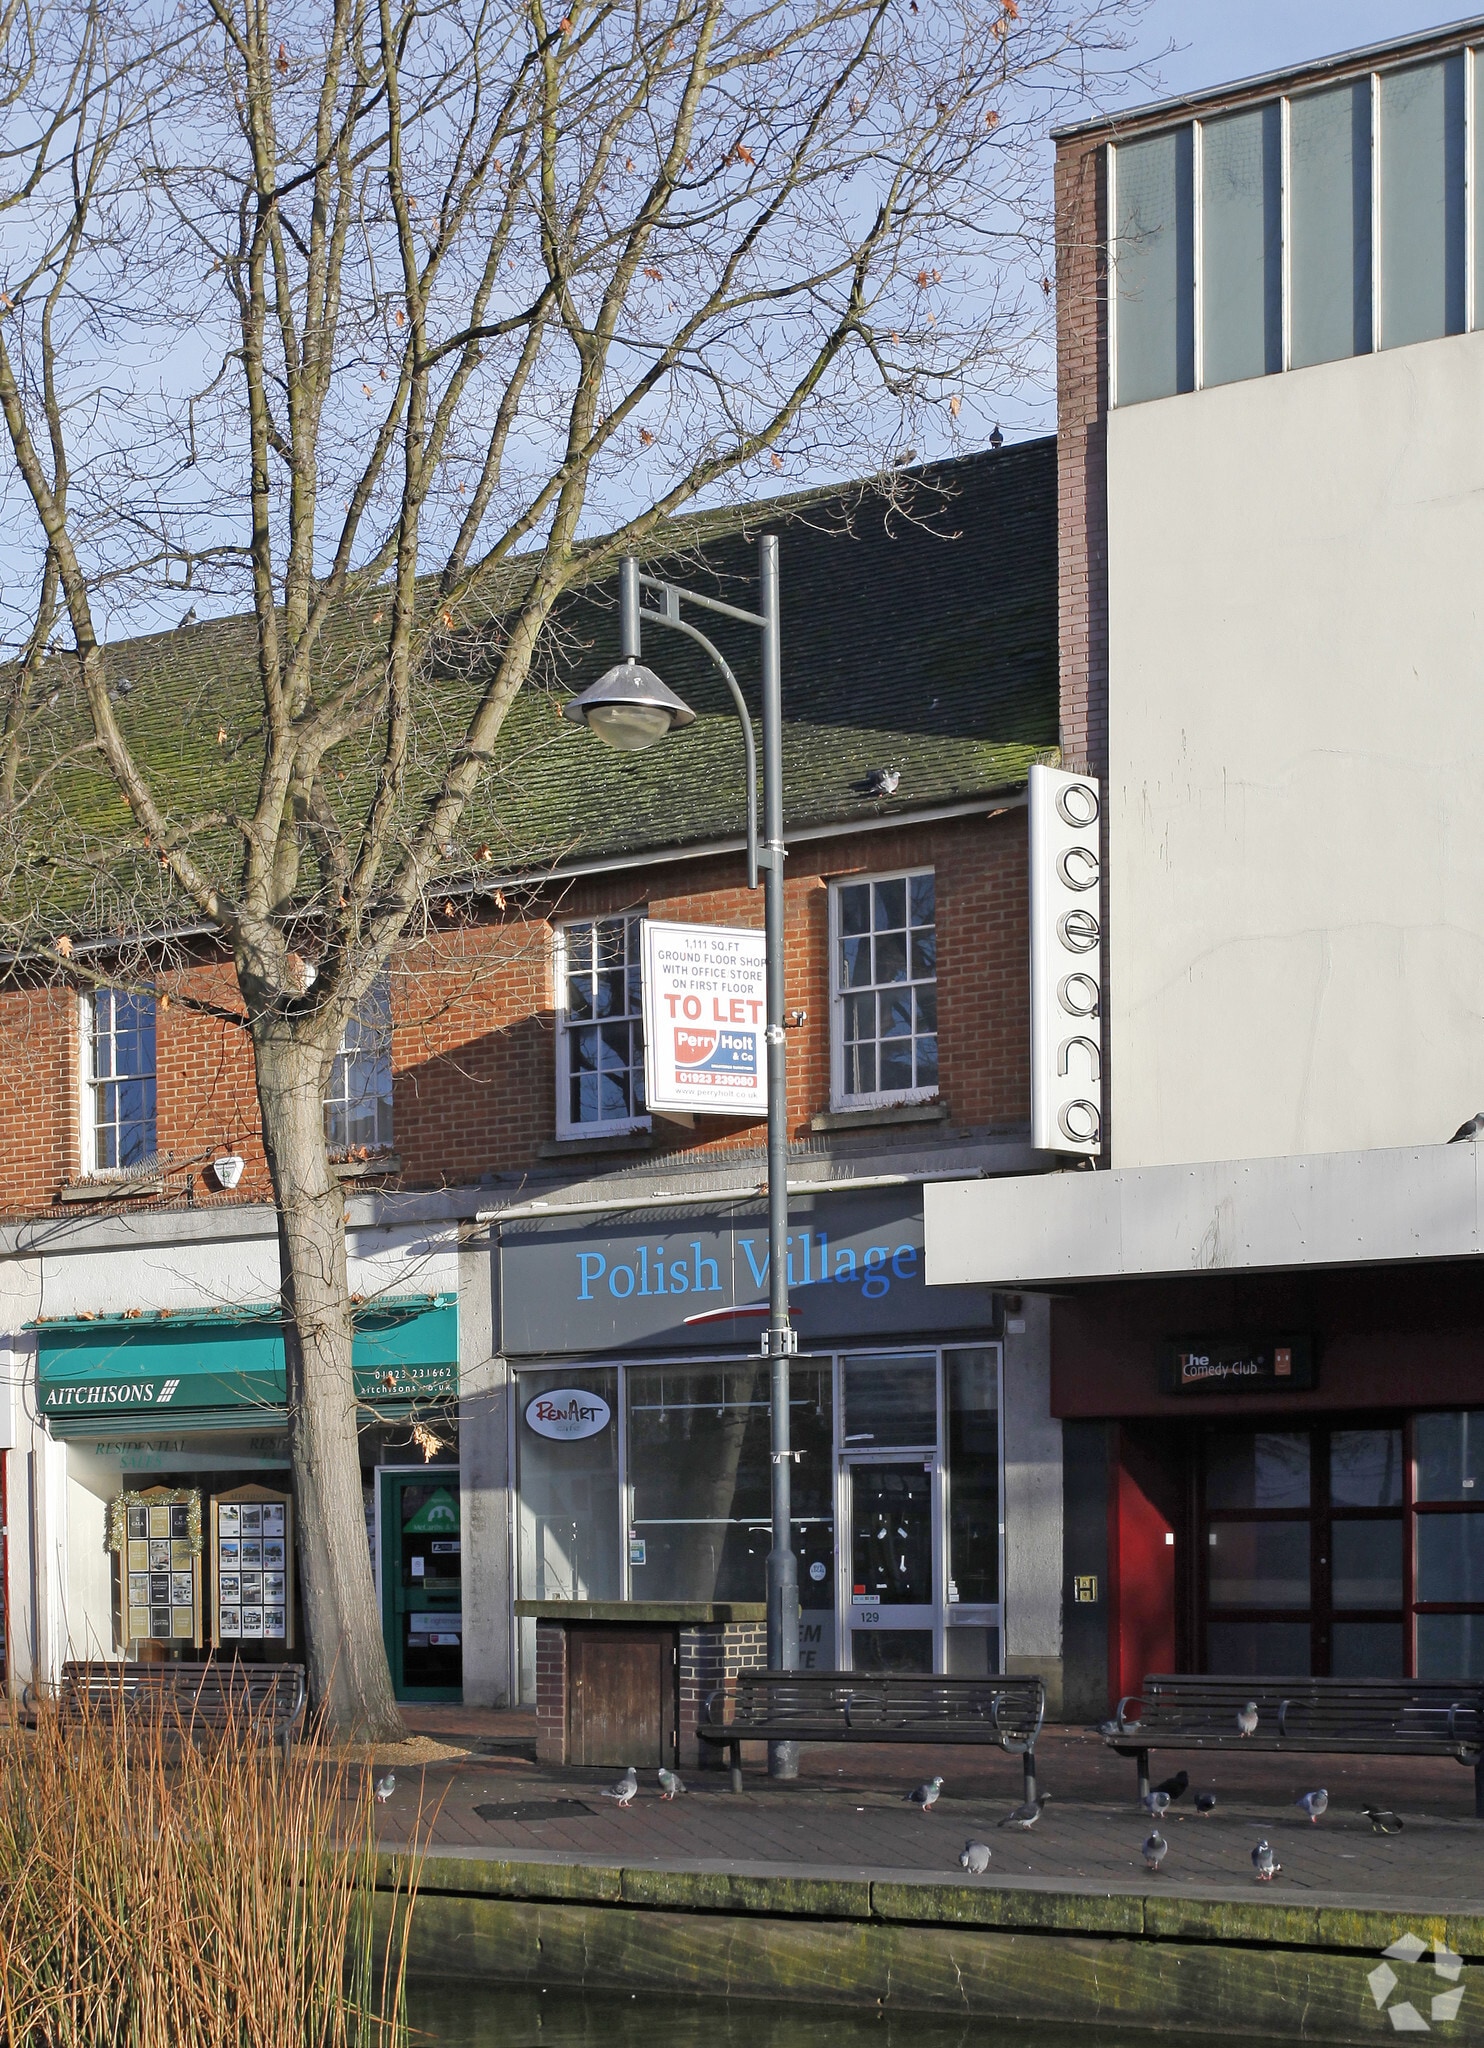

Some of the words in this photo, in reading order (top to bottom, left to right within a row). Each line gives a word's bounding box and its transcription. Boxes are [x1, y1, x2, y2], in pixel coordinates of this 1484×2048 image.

[711, 940, 740, 952] SQ.FT
[658, 950, 700, 962] GROUND
[704, 954, 737, 965] FLOOR
[740, 956, 767, 968] SHOP
[662, 964, 688, 975] WITH
[692, 966, 726, 978] OFFICE
[730, 970, 762, 981] STORE
[672, 978, 686, 988] ON
[690, 980, 718, 991] FIRST
[722, 982, 754, 994] FLOOR
[664, 994, 702, 1020] TO
[713, 998, 763, 1024] LET
[677, 1032, 716, 1048] Perry
[721, 1034, 753, 1050] Holt
[732, 1052, 740, 1061] &
[741, 1052, 754, 1062] Co
[680, 1072, 712, 1084] 01923
[576, 1241, 722, 1300] Polish
[738, 1232, 917, 1299] Village
[374, 1369, 406, 1380] 01923
[412, 1368, 451, 1378] 231662
[1183, 1362, 1228, 1378] Comedy
[1232, 1361, 1258, 1375] Club
[45, 1384, 154, 1406] AITCHISONS
[96, 1440, 185, 1454] RESIDENTIAL
[120, 1456, 162, 1469] SALES
[861, 1612, 880, 1622] 129
